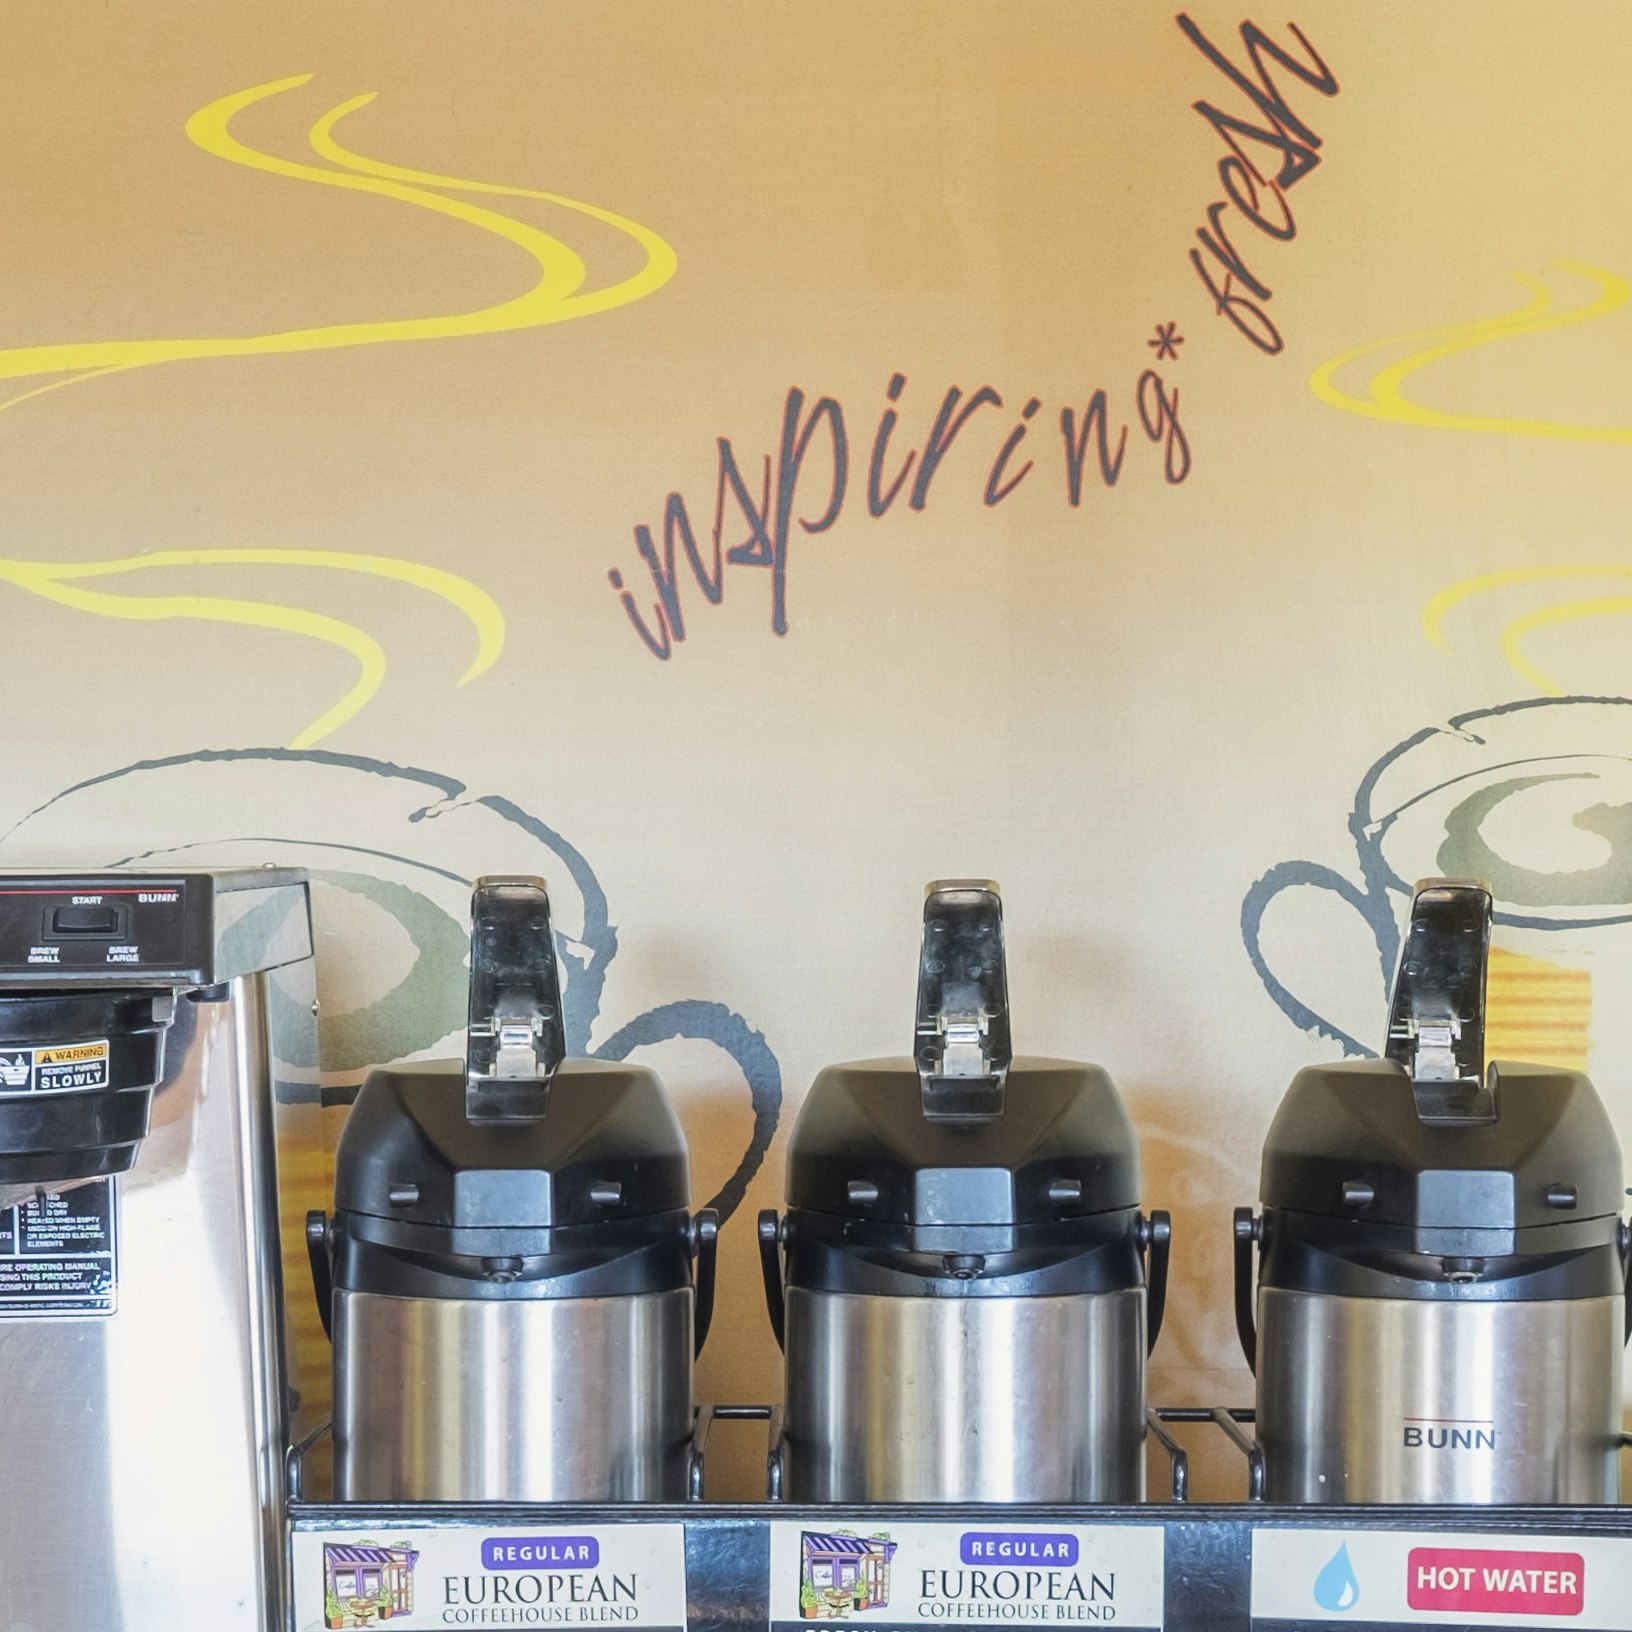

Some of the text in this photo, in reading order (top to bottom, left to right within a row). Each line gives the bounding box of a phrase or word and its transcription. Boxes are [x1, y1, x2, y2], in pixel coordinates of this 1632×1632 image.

[71, 896, 103, 905] START
[138, 893, 177, 903] BUNN
[30, 946, 60, 955] BREW
[108, 945, 139, 954] BREW
[27, 954, 61, 963] SMALL
[106, 954, 139, 963] LARGE
[55, 1046, 104, 1060] WARNING
[39, 1071, 103, 1089] SLOWLY
[65, 1262, 100, 1270] MANUAL
[21, 1273, 41, 1281] THIS
[42, 1272, 83, 1280] PRODUCT
[61, 1281, 92, 1290] INJURY
[1403, 1426, 1496, 1450] BUNN
[492, 1543, 590, 1562] REGULAR
[971, 1540, 1070, 1558] REGULAR
[920, 1568, 1116, 1601] EUROPEAN
[1416, 1566, 1578, 1595] HOT WATER
[442, 1573, 639, 1605] EUROPEAN
[442, 1605, 639, 1625] COFFEEHOUSE BLEND
[918, 1602, 1116, 1621] COFFEEHOUSE BLEND
